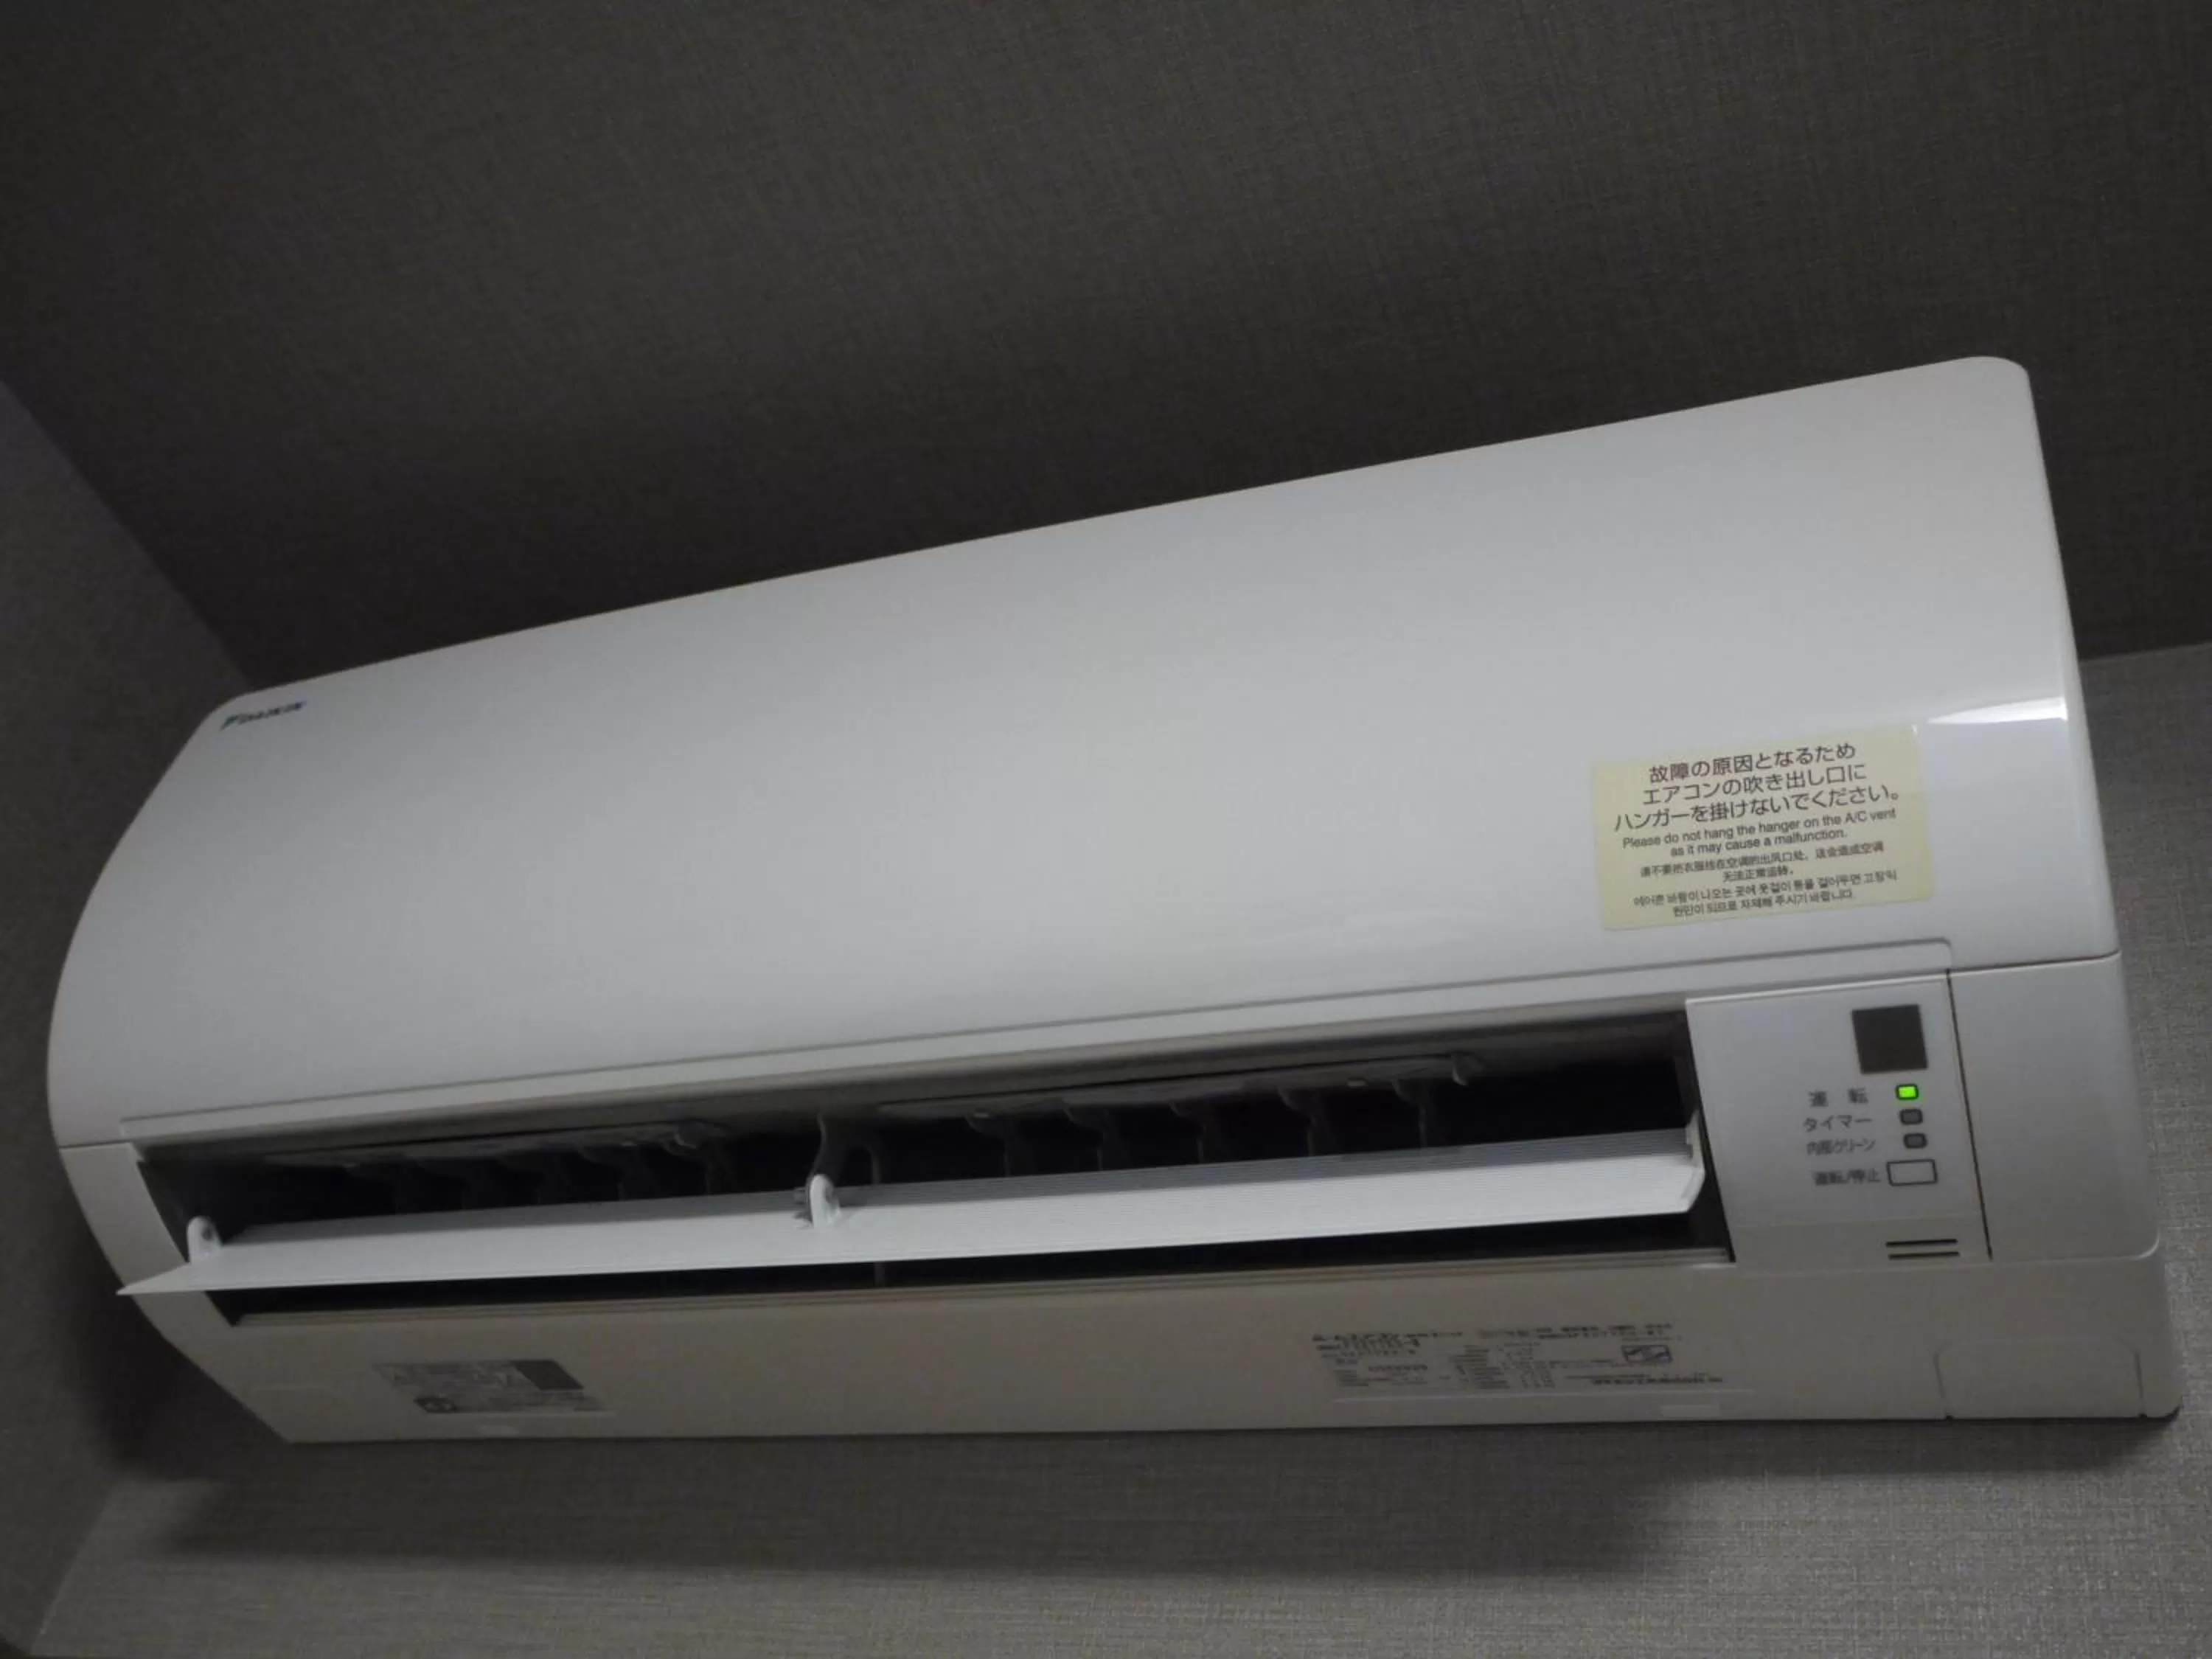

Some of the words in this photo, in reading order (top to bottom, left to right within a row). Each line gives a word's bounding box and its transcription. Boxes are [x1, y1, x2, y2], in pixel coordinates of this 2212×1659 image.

[1649, 742, 1857, 784] 故障の原因となるため
[1643, 763, 1868, 806] エアコンの吹き出し口に
[1614, 784, 1900, 832] ハンガーを掛けないでください。
[1623, 836, 1661, 848] Please
[1664, 832, 1679, 844] do
[1683, 830, 1702, 841] not
[1704, 827, 1733, 840] hang
[1736, 824, 1756, 835] the
[1759, 818, 1801, 832] hanger
[1804, 818, 1819, 829] on
[1823, 814, 1842, 826] the
[1845, 810, 1868, 824] A/C
[1870, 807, 1896, 821] vent
[1670, 846, 1684, 857] as
[1687, 844, 1695, 855] it
[1697, 842, 1722, 854] may
[1725, 838, 1760, 850] cause
[1763, 837, 1772, 846] a
[1774, 828, 1848, 844] malfunction.
[1803, 1115, 1873, 1132] タイマー
